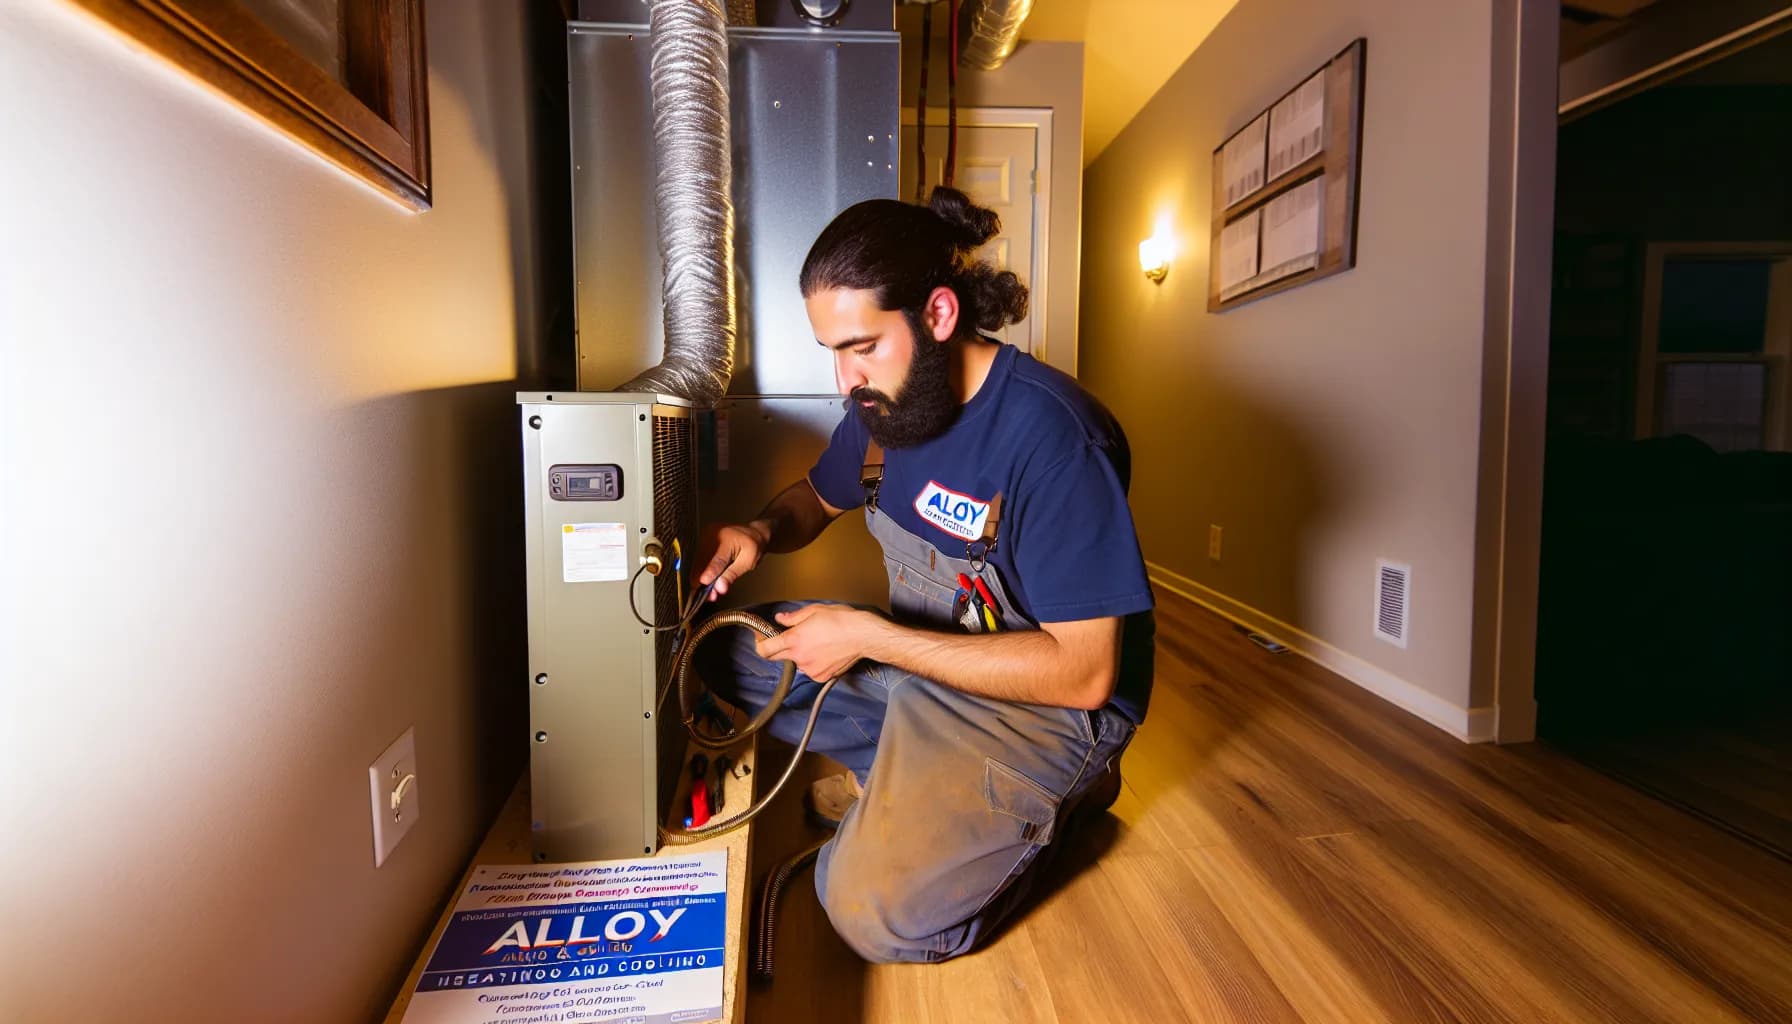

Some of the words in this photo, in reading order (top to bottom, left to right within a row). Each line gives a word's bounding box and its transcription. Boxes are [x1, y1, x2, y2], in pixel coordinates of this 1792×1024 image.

[928, 492, 986, 525] ALOY
[483, 907, 687, 954] ALLOY
[569, 963, 609, 978] AND
